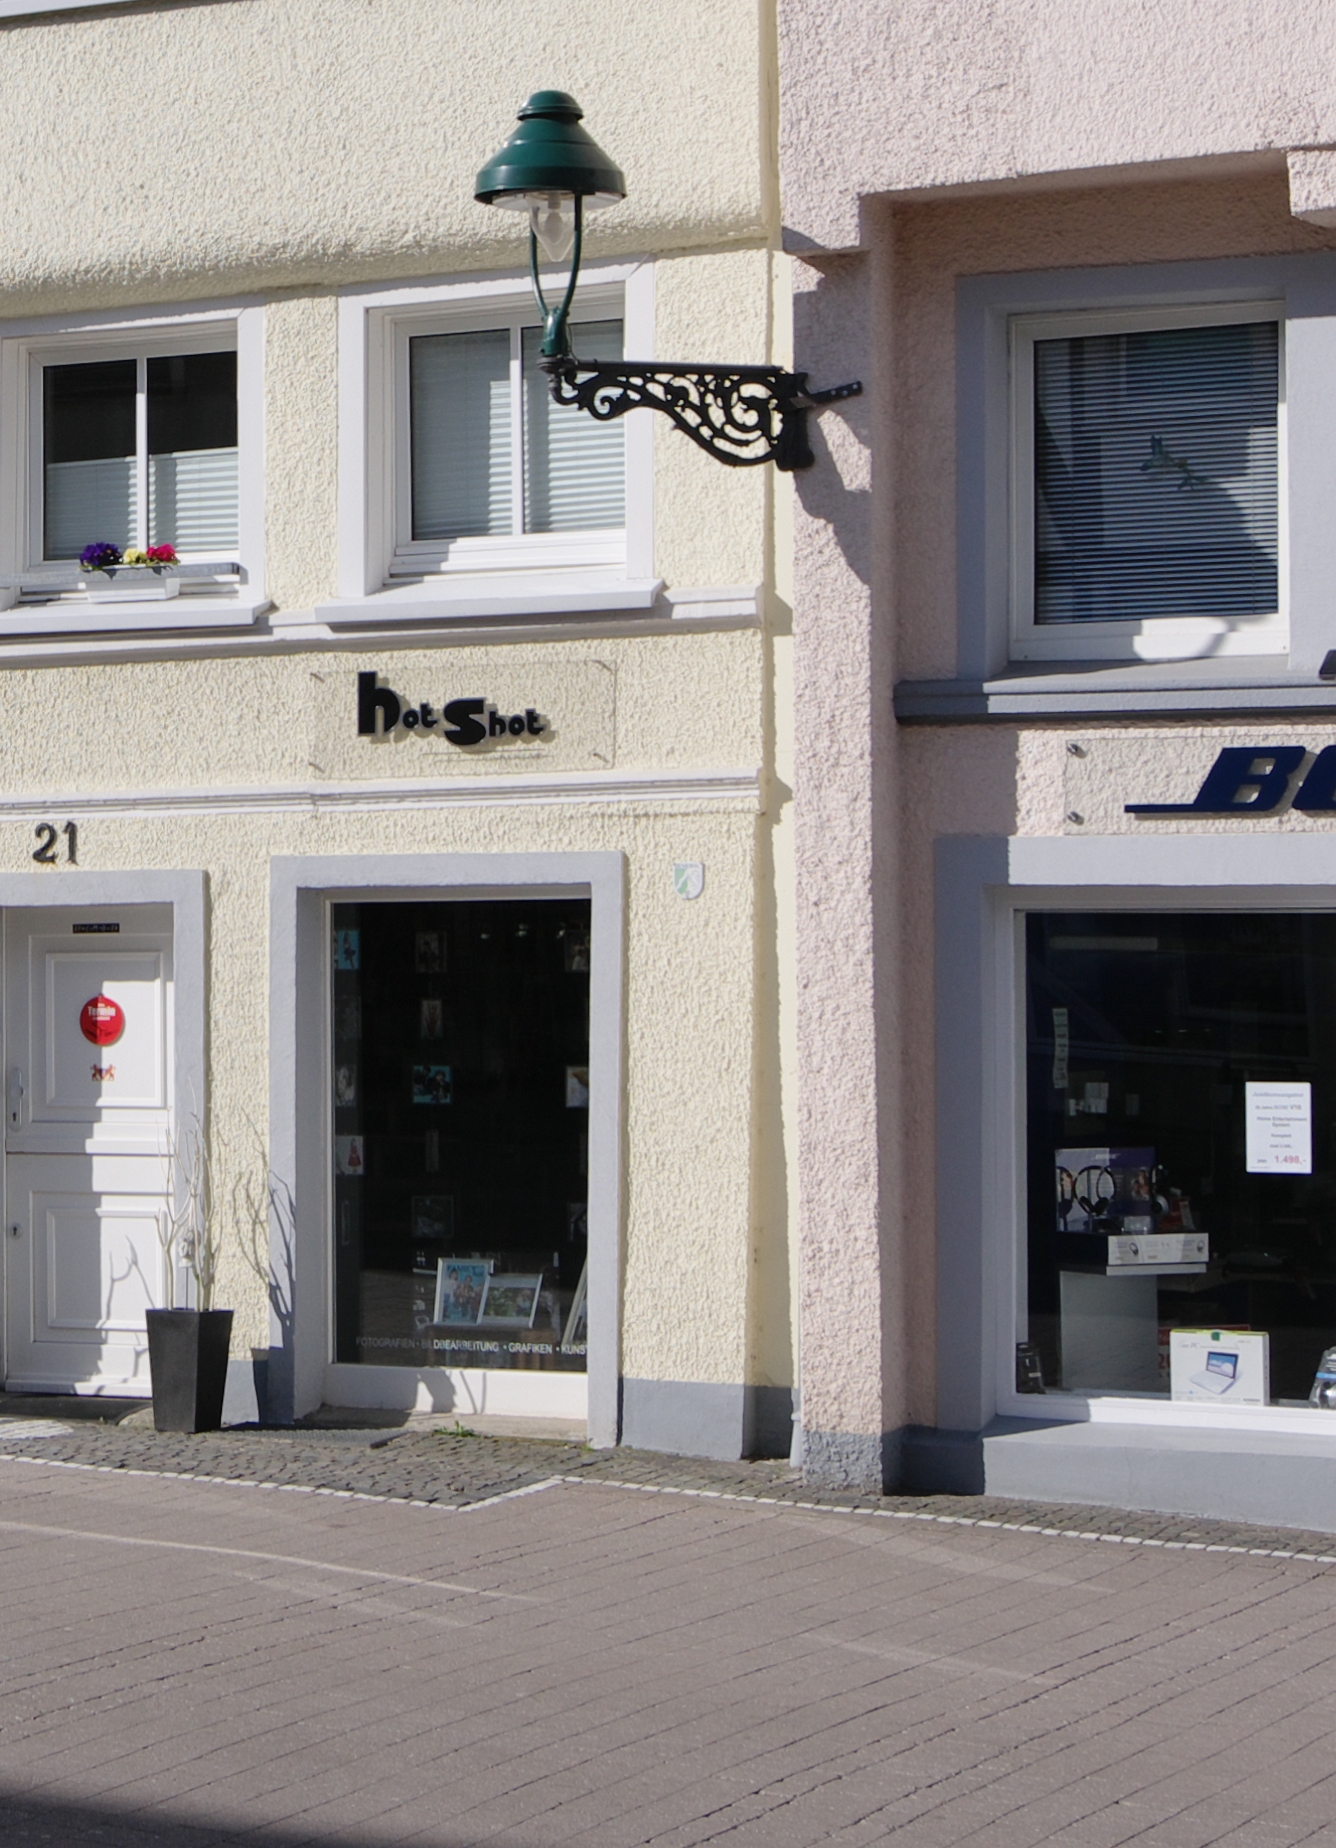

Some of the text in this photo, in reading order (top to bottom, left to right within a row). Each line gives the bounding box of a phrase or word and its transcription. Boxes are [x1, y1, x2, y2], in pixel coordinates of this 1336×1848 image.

[357, 670, 546, 746] hot Shot
[32, 821, 79, 865] 21
[87, 1005, 116, 1017] Termin
[507, 1342, 553, 1355] GRAFIKEN
